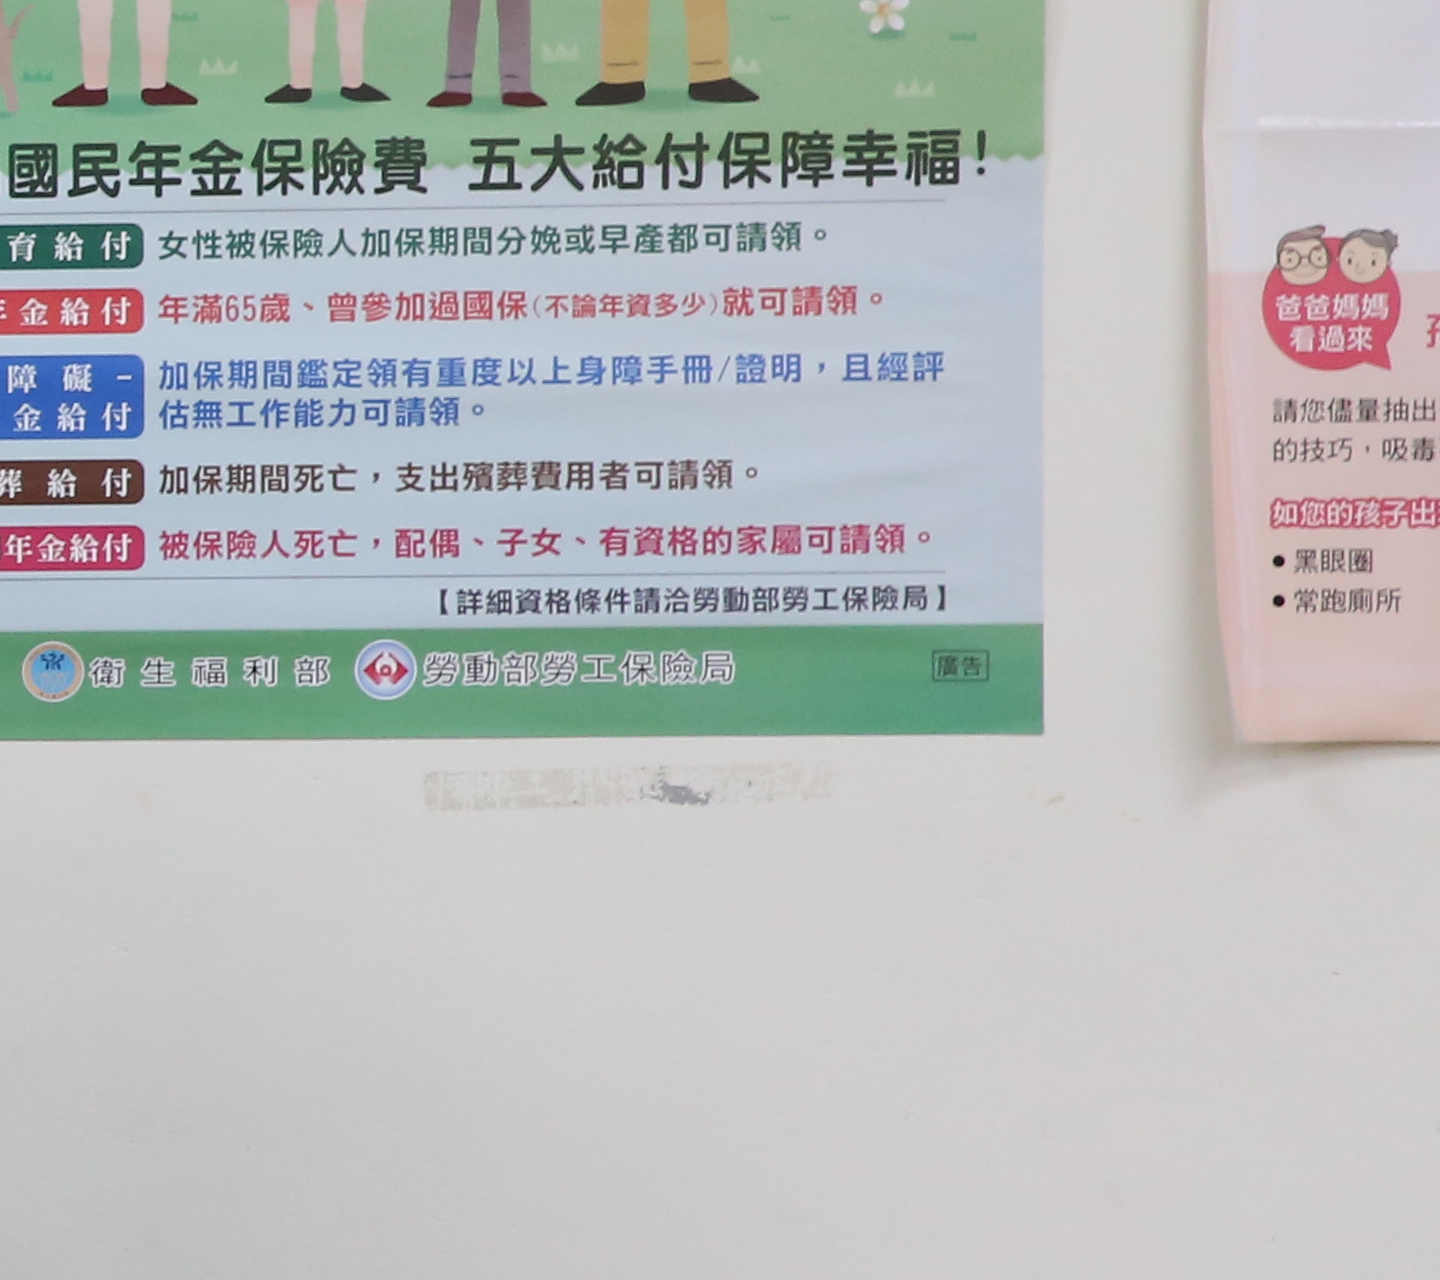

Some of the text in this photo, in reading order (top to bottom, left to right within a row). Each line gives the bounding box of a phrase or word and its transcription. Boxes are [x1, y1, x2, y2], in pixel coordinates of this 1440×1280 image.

[467, 128, 988, 193] 五大給付保障幸福!
[158, 221, 829, 261] 女性被保險人加保期間分娩或早產都可請領。
[1275, 293, 1390, 321] 爸爸媽媽
[1290, 324, 1374, 353] 看過來
[158, 395, 486, 431] 估無工作能力可請領。
[1272, 396, 1440, 424] 請您儘量抽出
[1272, 436, 1440, 463] 的技巧,吸毒
[1271, 498, 1440, 529] 如您的孩子出
[1293, 548, 1374, 574] 黑眼圈
[1293, 587, 1402, 614] 常跑廁所
[88, 650, 737, 690] 衛生福利部 勞動部勞工保險局
